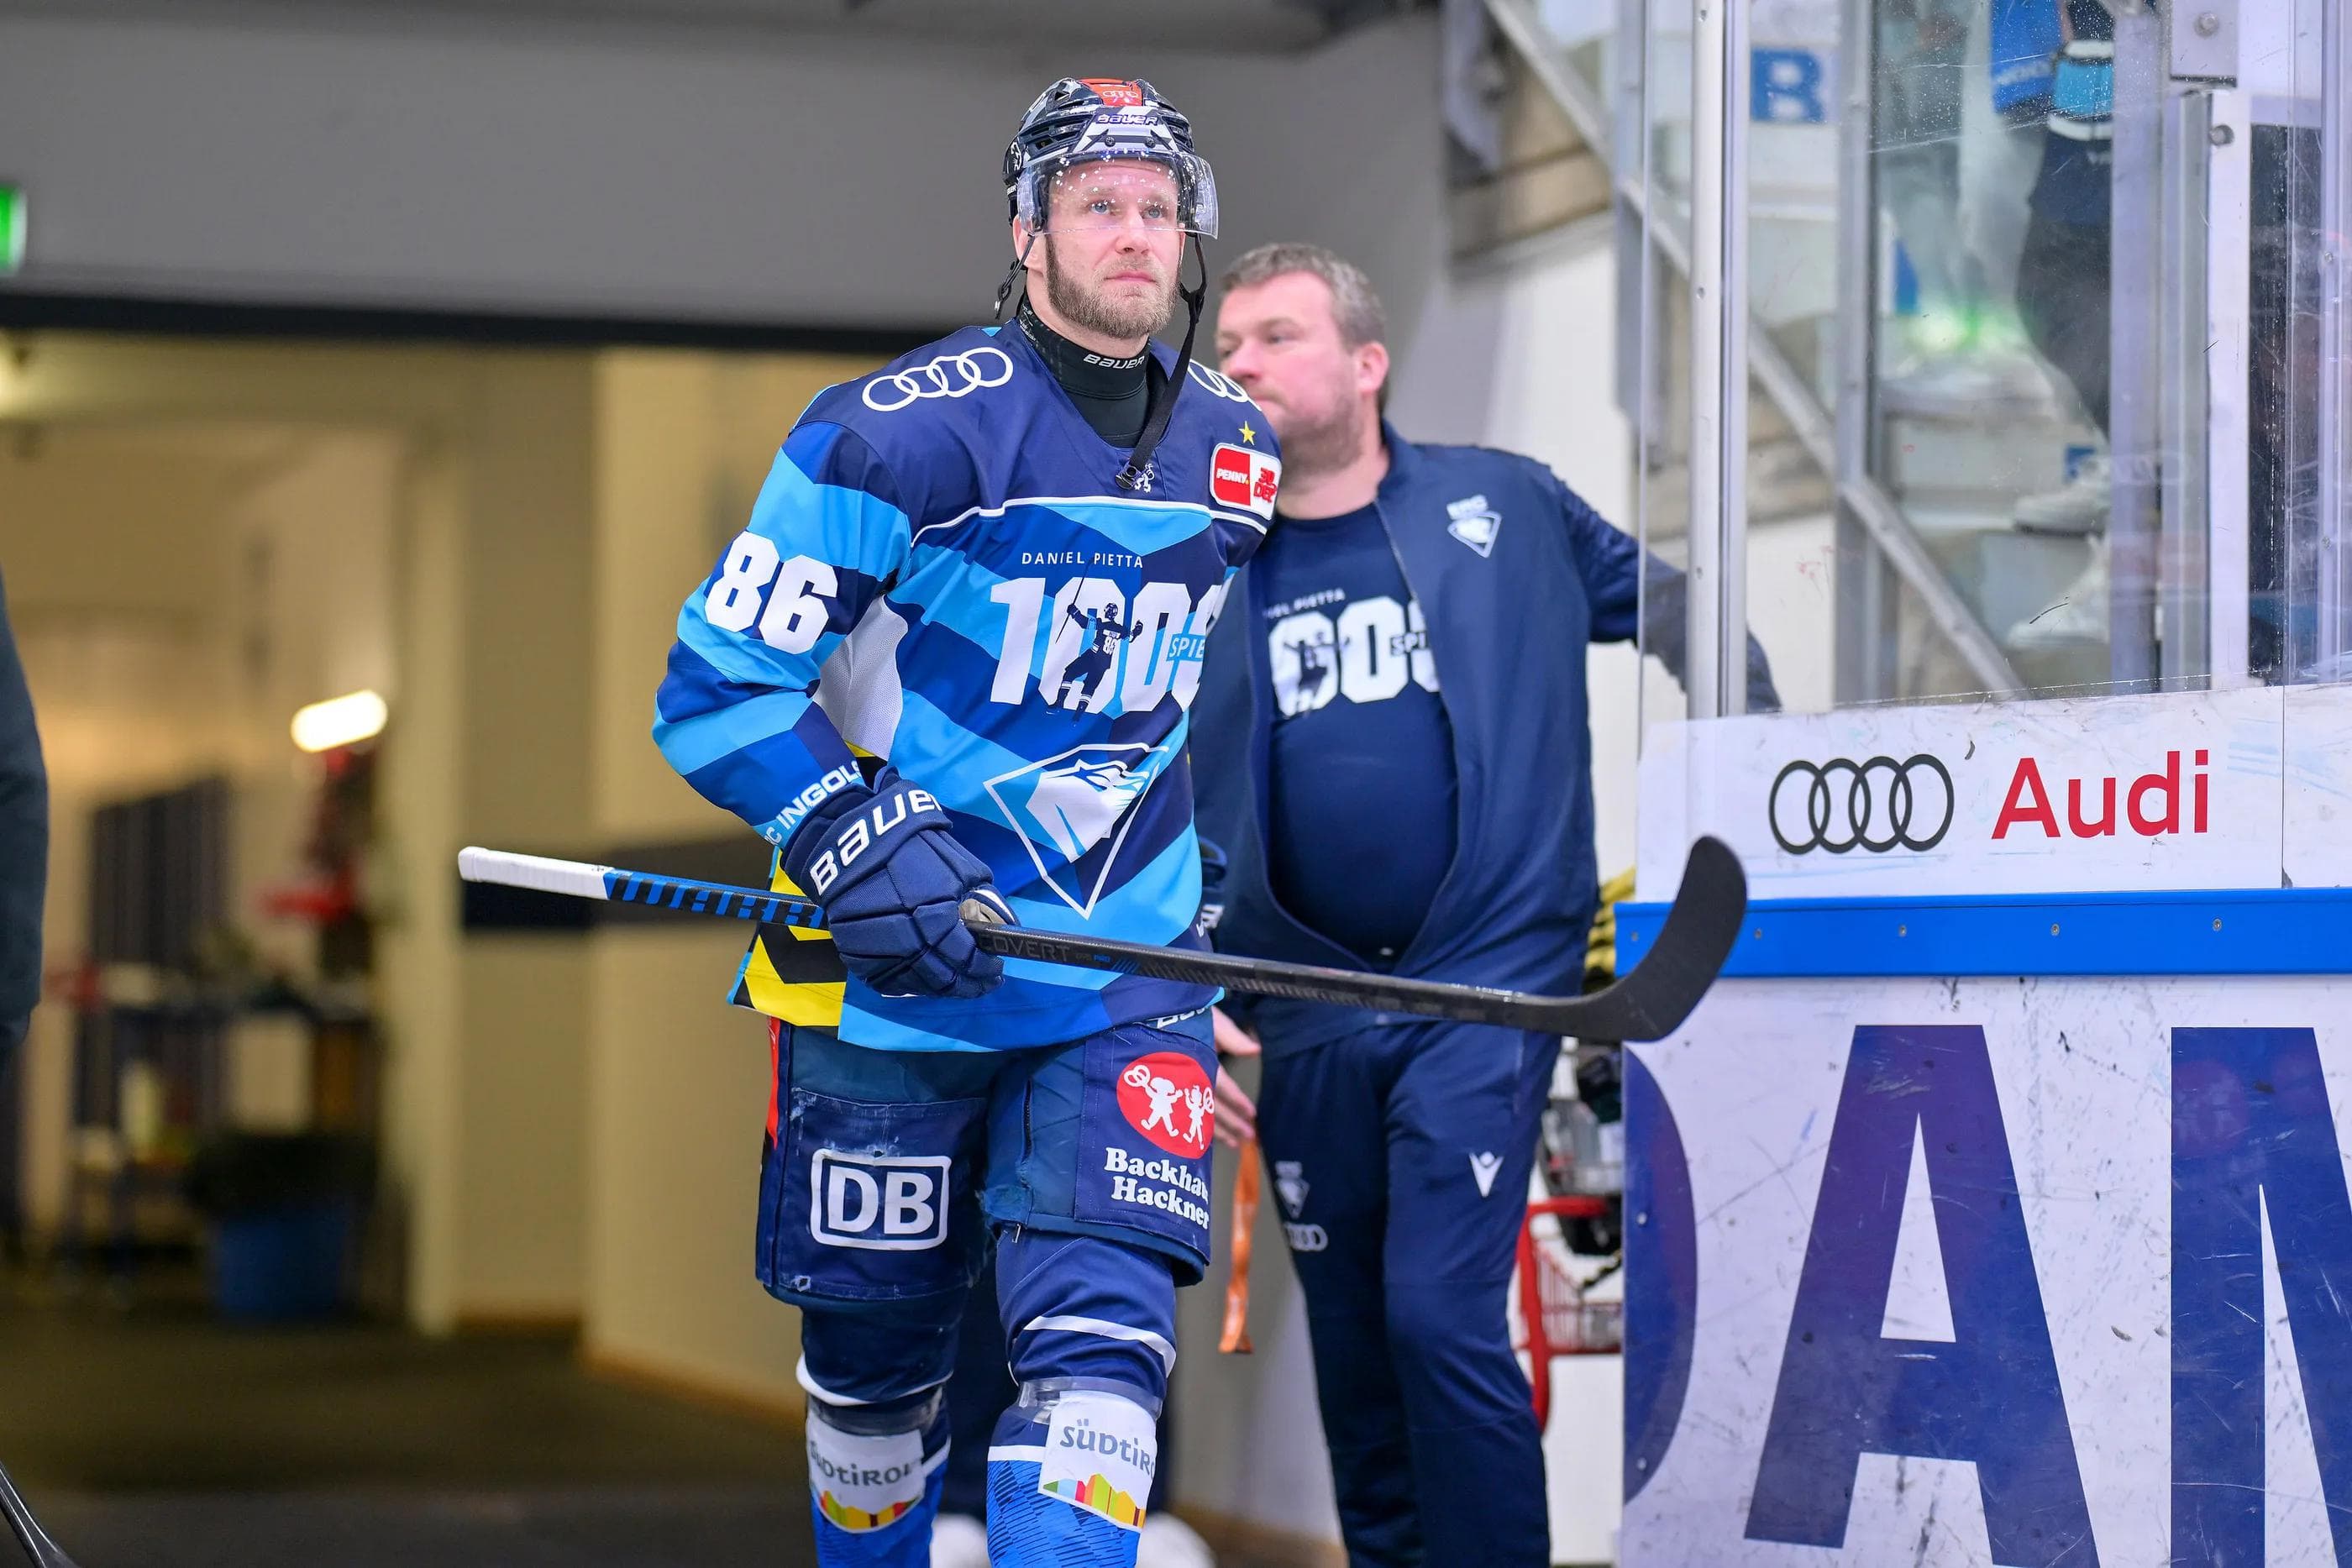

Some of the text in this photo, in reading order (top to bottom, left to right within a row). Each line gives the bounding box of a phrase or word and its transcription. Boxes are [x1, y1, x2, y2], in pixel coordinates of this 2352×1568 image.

[704, 530, 838, 655] 86
[1021, 551, 1143, 569] DANIEL PIETTA
[1992, 749, 2208, 840] Audi
[827, 1165, 935, 1235] DB
